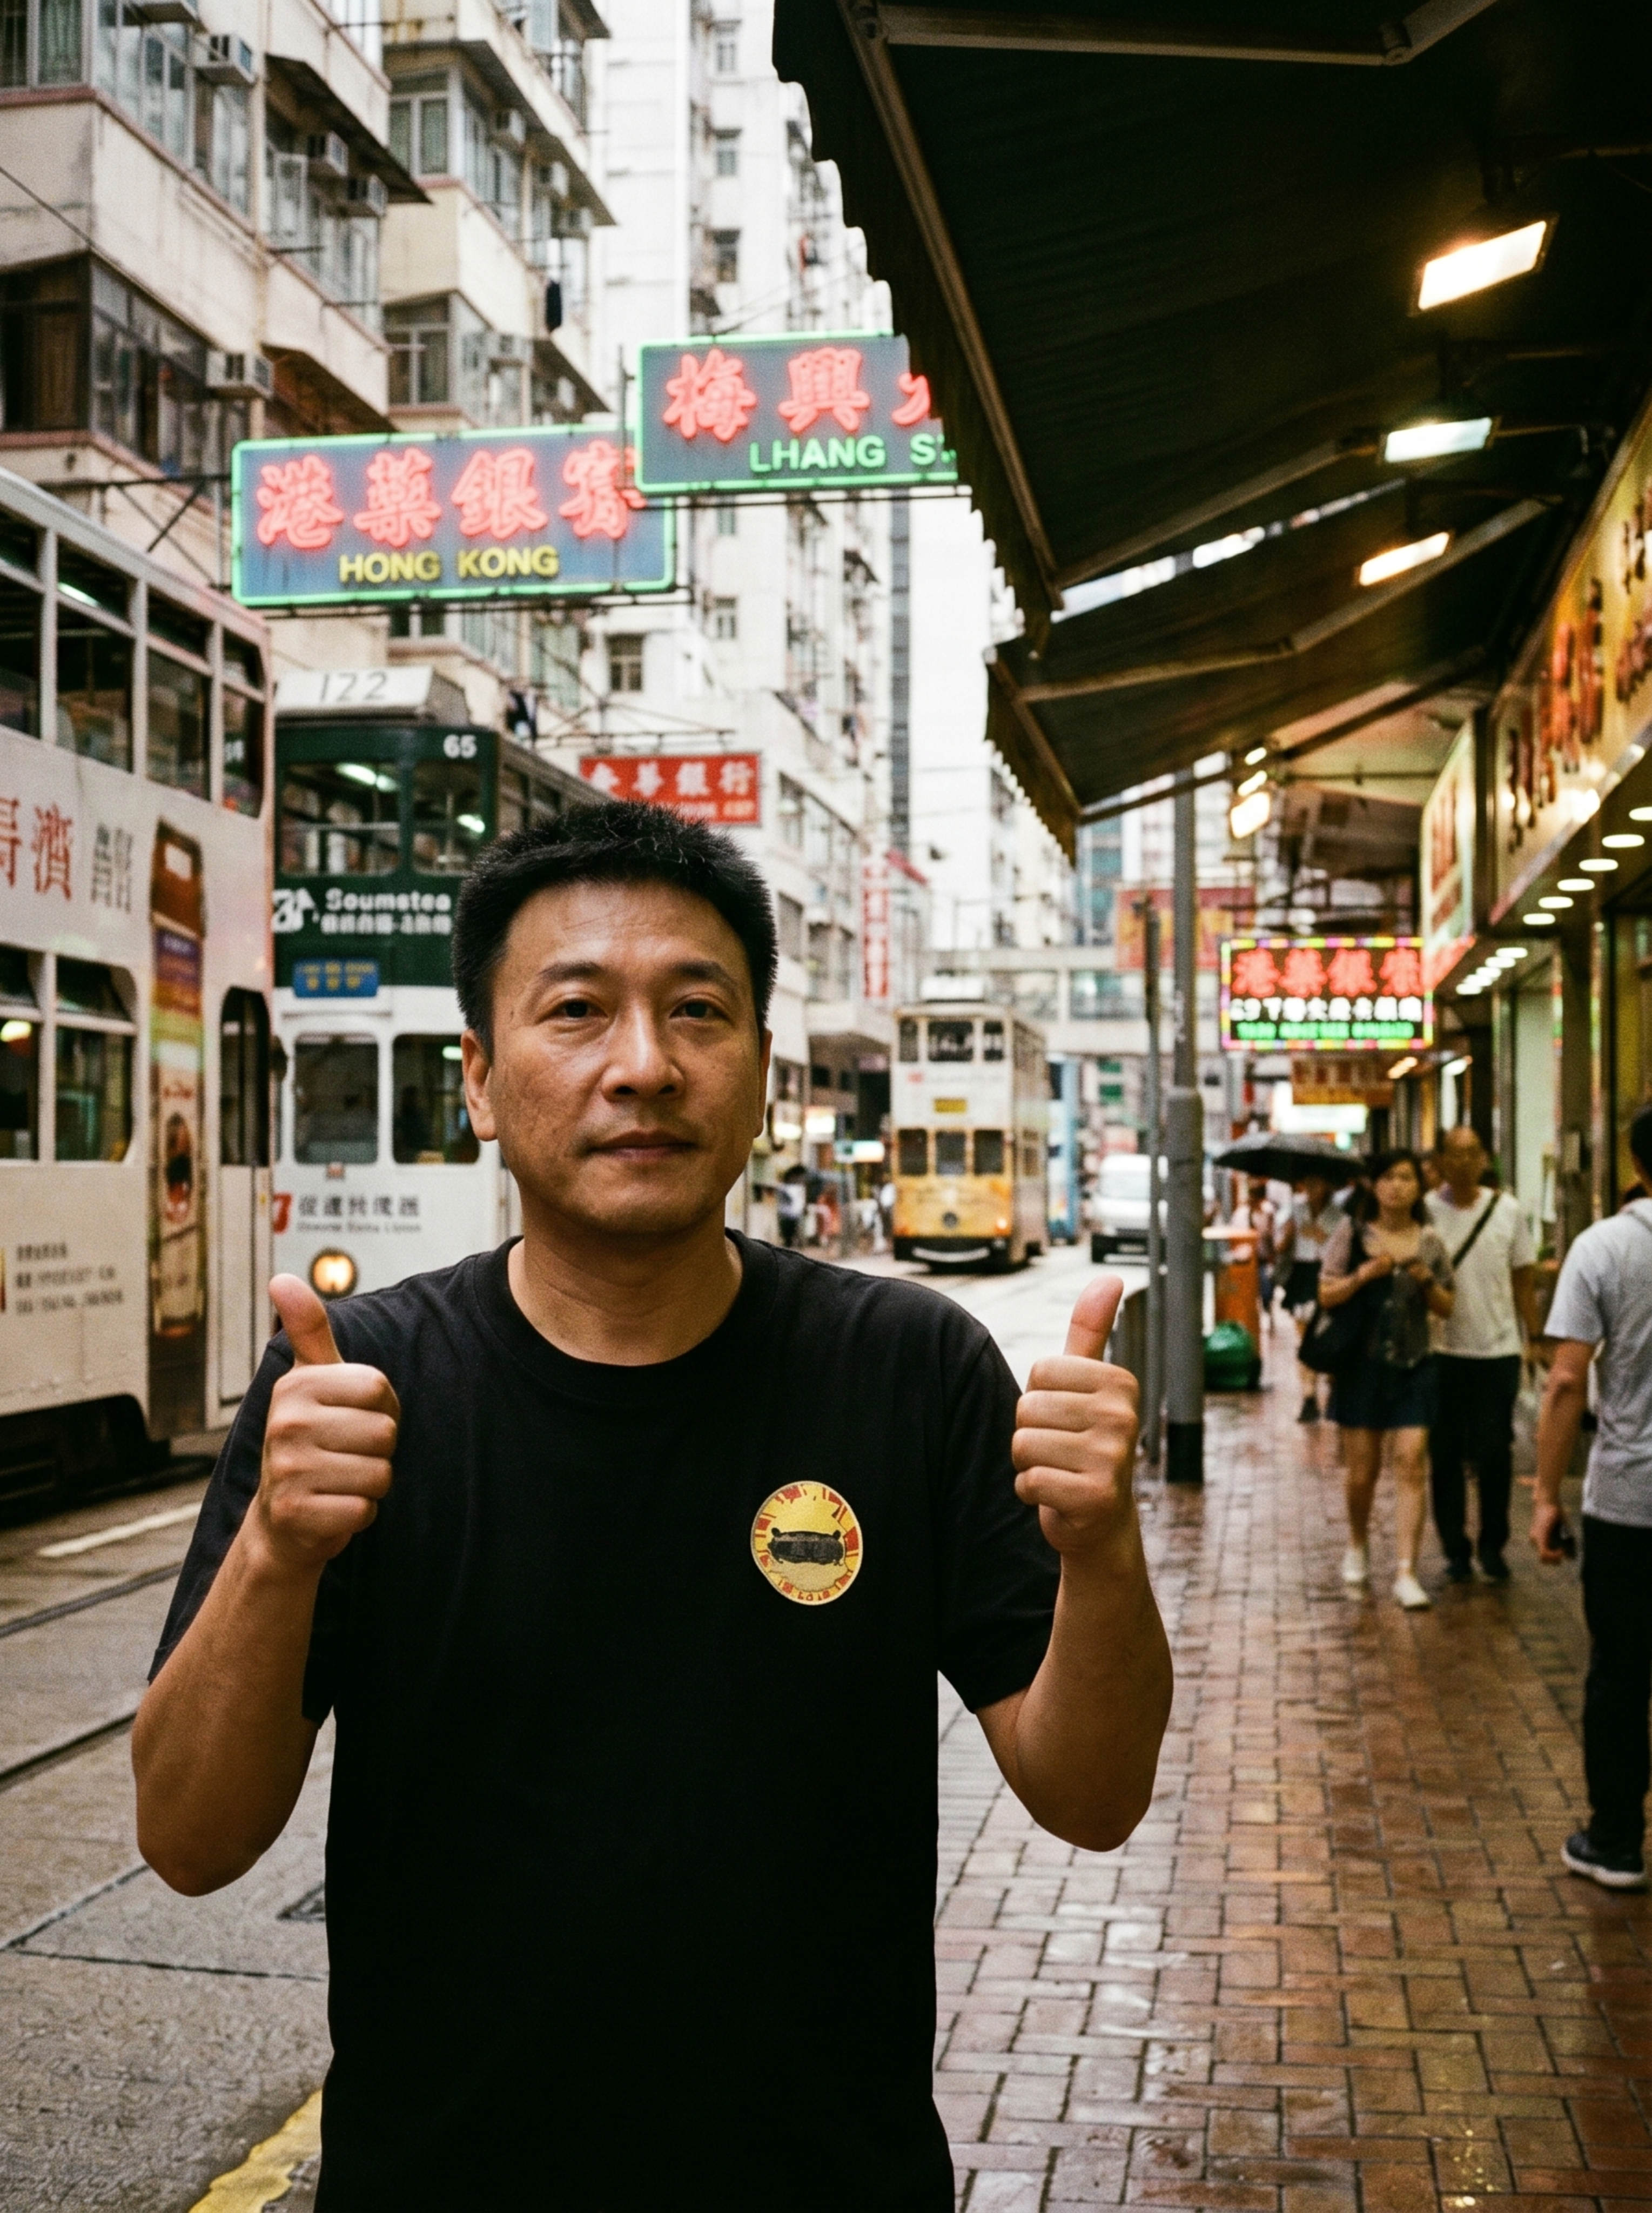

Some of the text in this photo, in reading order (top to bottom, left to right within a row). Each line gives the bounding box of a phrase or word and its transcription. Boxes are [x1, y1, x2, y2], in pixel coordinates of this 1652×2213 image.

[749, 435, 887, 472] LHANG
[339, 545, 560, 584] HONG KONG
[442, 734, 478, 759] 65
